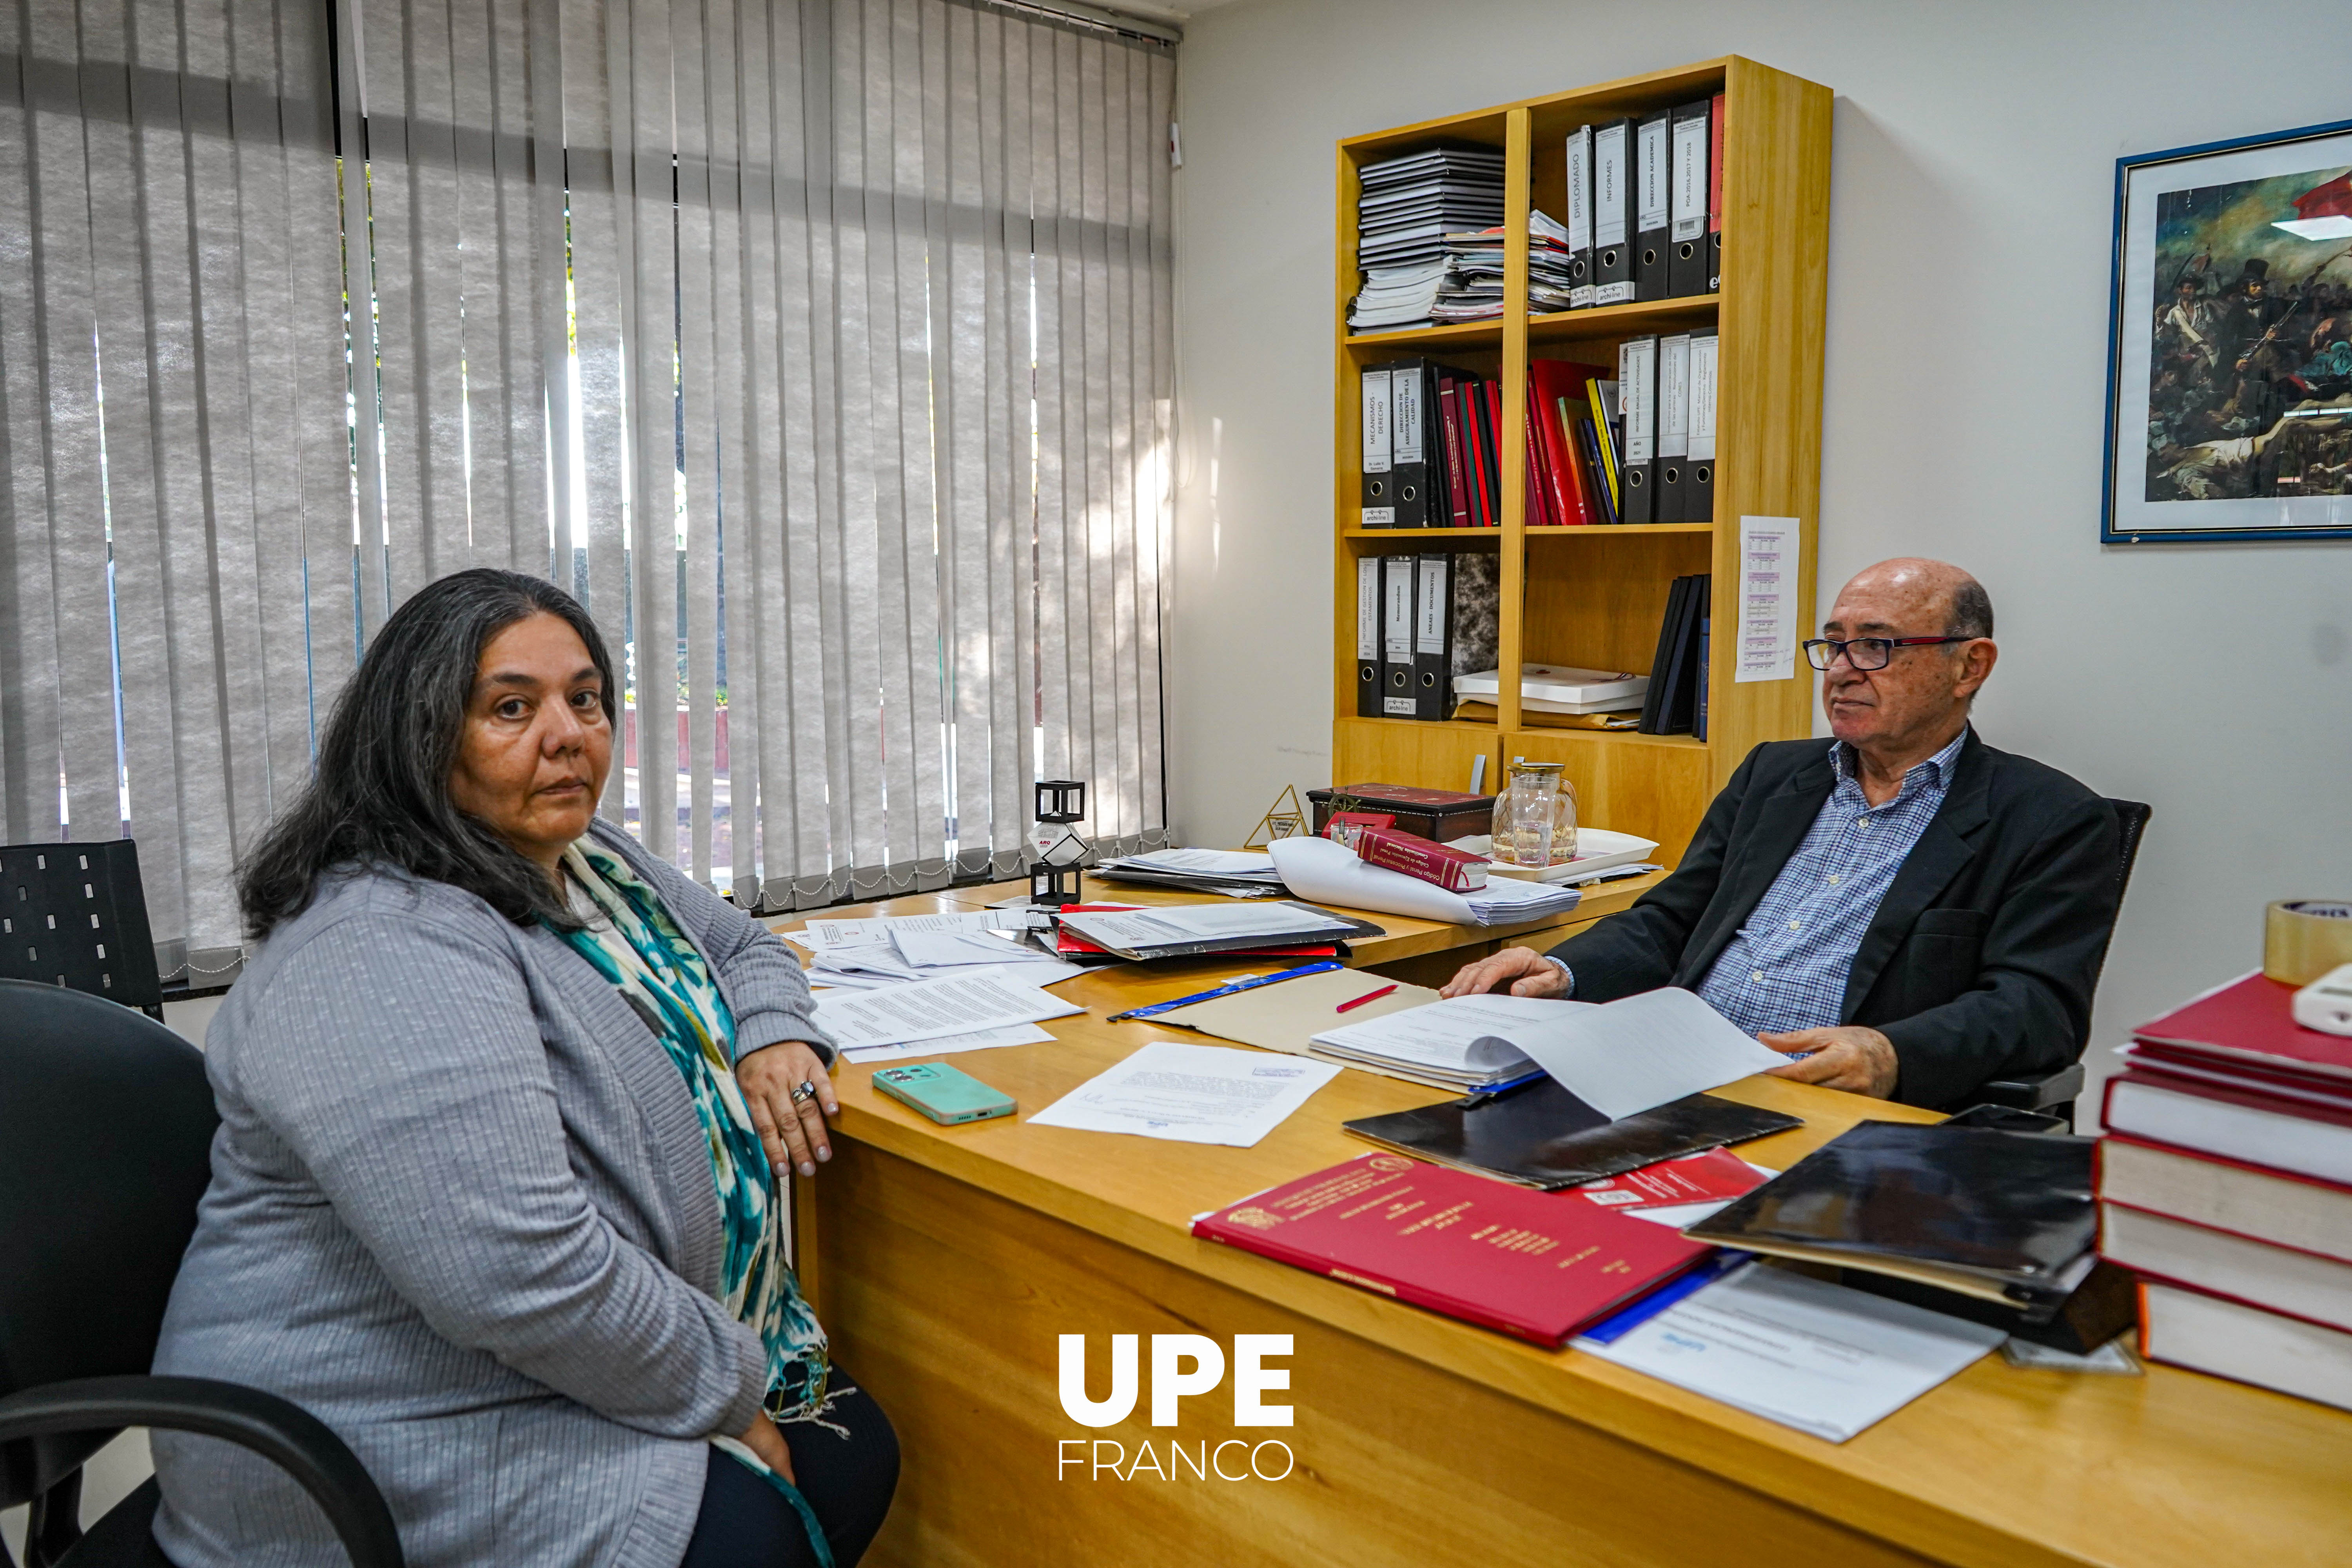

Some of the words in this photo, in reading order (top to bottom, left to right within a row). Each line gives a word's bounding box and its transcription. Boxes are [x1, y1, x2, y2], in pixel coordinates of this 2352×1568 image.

[1405, 388, 1409, 397] DE
[1387, 842, 1404, 851] Nacional
[1392, 852, 1409, 862] Ejecución
[1404, 848, 1428, 859] Constitución
[1373, 854, 1386, 863] Penal
[1387, 859, 1405, 869] Procesal
[1410, 867, 1423, 875] Penal
[1423, 871, 1440, 880] Código
